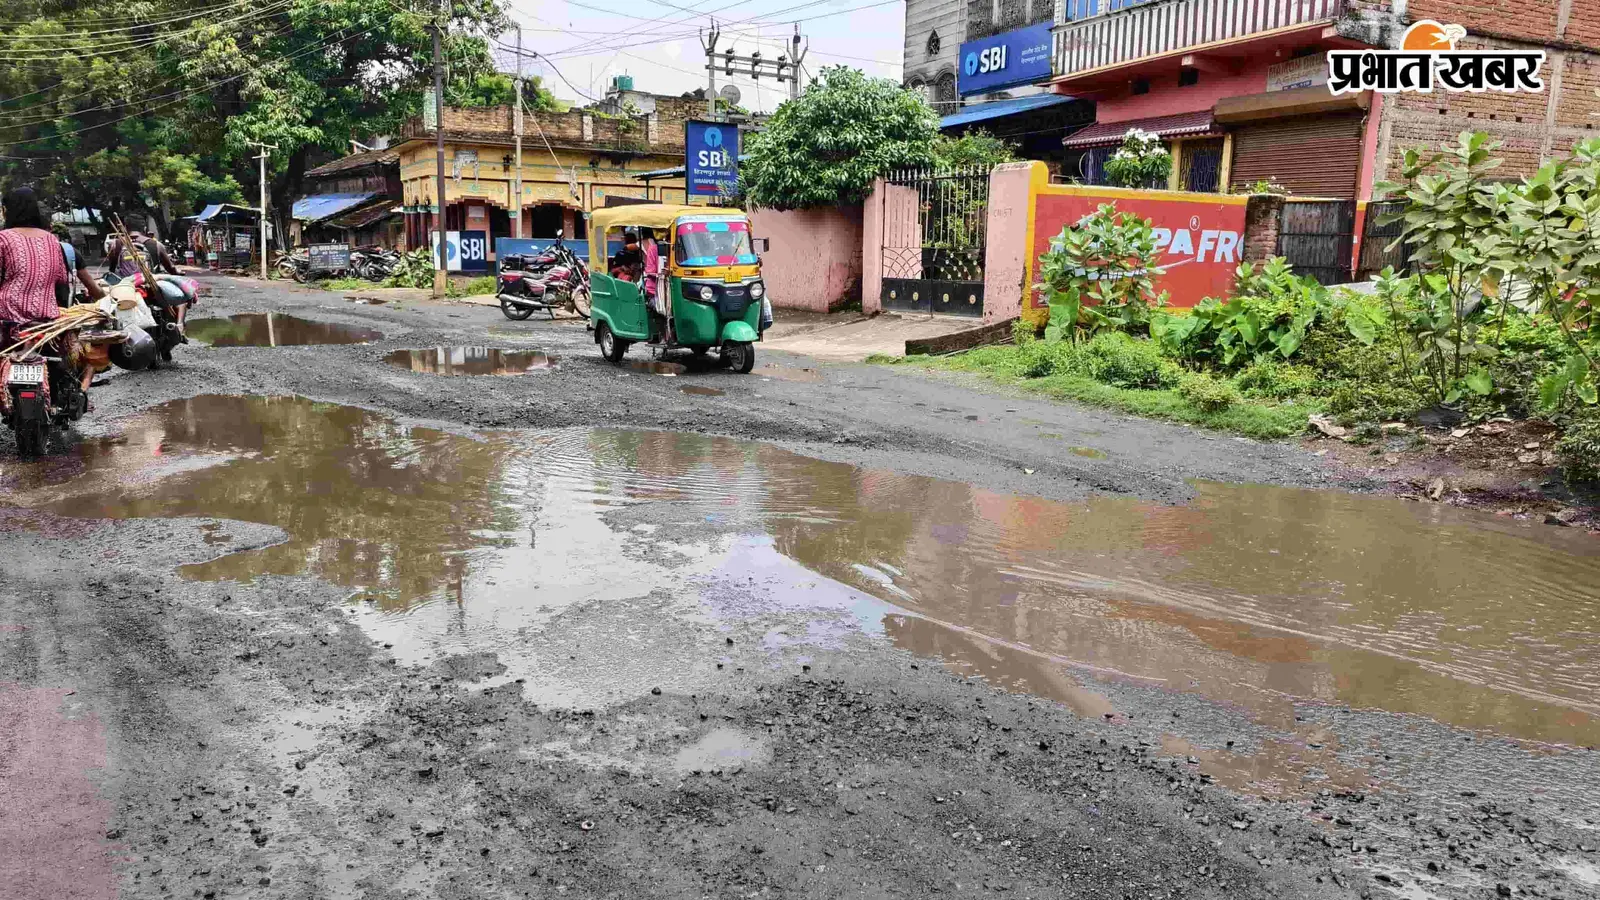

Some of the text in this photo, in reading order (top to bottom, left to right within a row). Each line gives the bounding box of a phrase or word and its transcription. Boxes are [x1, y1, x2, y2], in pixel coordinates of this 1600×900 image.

[980, 45, 1007, 74] SBI
[698, 150, 727, 167] SBI
[461, 238, 484, 260] SBI
